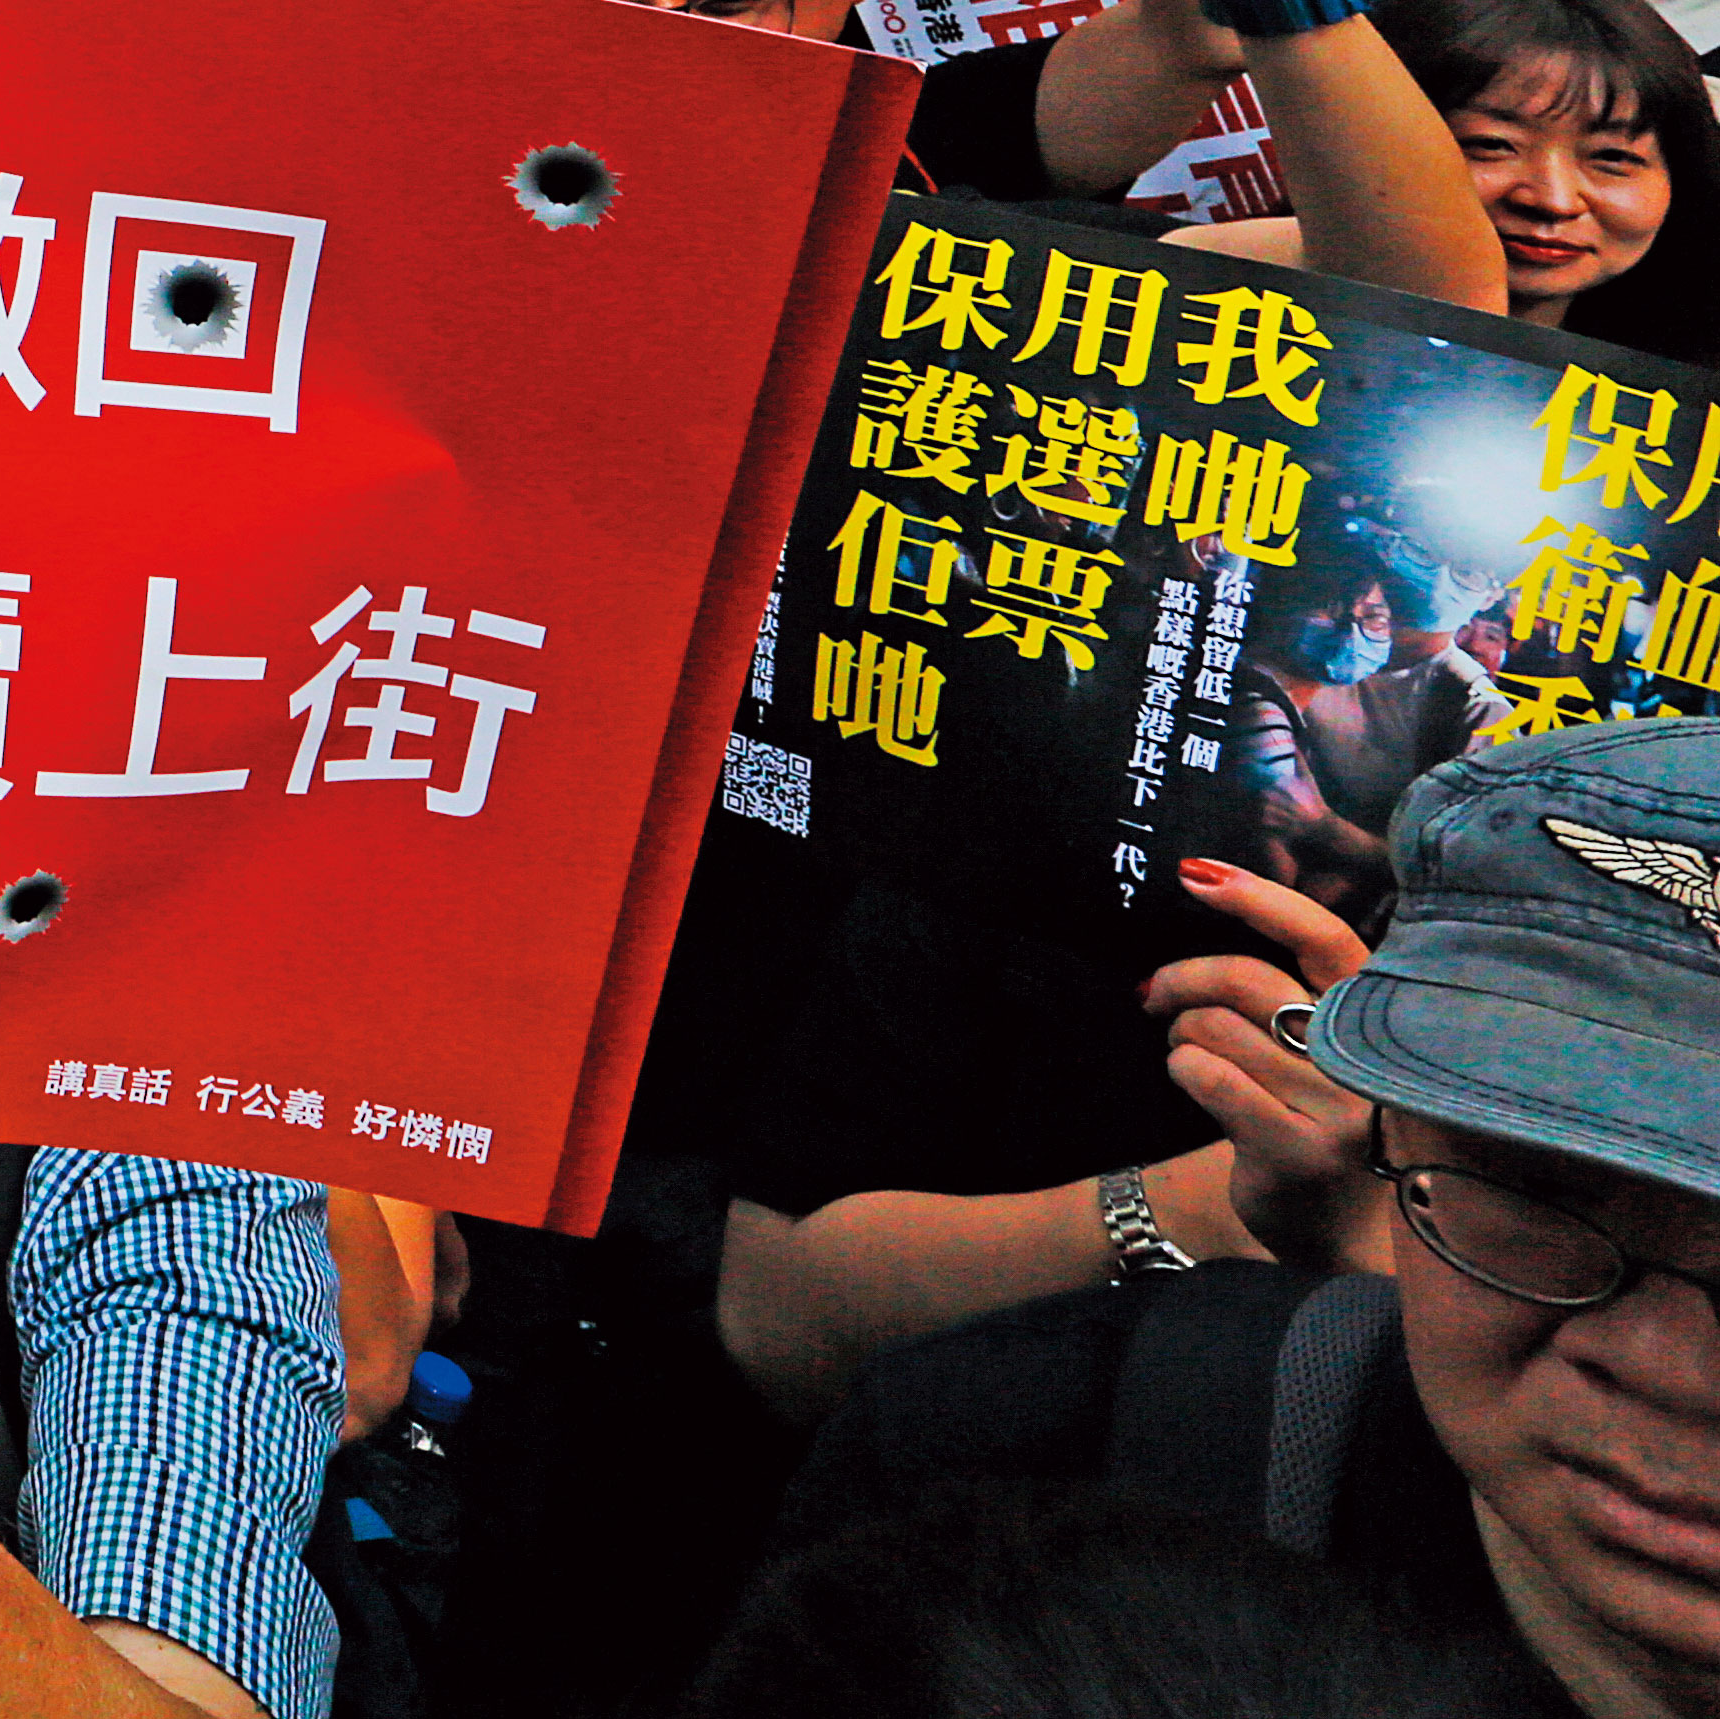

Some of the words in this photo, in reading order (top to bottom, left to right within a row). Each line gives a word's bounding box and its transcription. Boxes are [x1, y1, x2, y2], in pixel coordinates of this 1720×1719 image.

[811, 220, 1017, 770] 保護佢哋
[964, 246, 1169, 675] 用選票
[1141, 285, 1334, 570] 我哋
[1111, 576, 1202, 910] 點樣嘅香港比下一代?
[1179, 567, 1256, 775] 你想留低一個
[42, 1058, 174, 1114] 講真話
[197, 1075, 328, 1135] 行公義
[353, 1099, 495, 1172] 好憐憫
